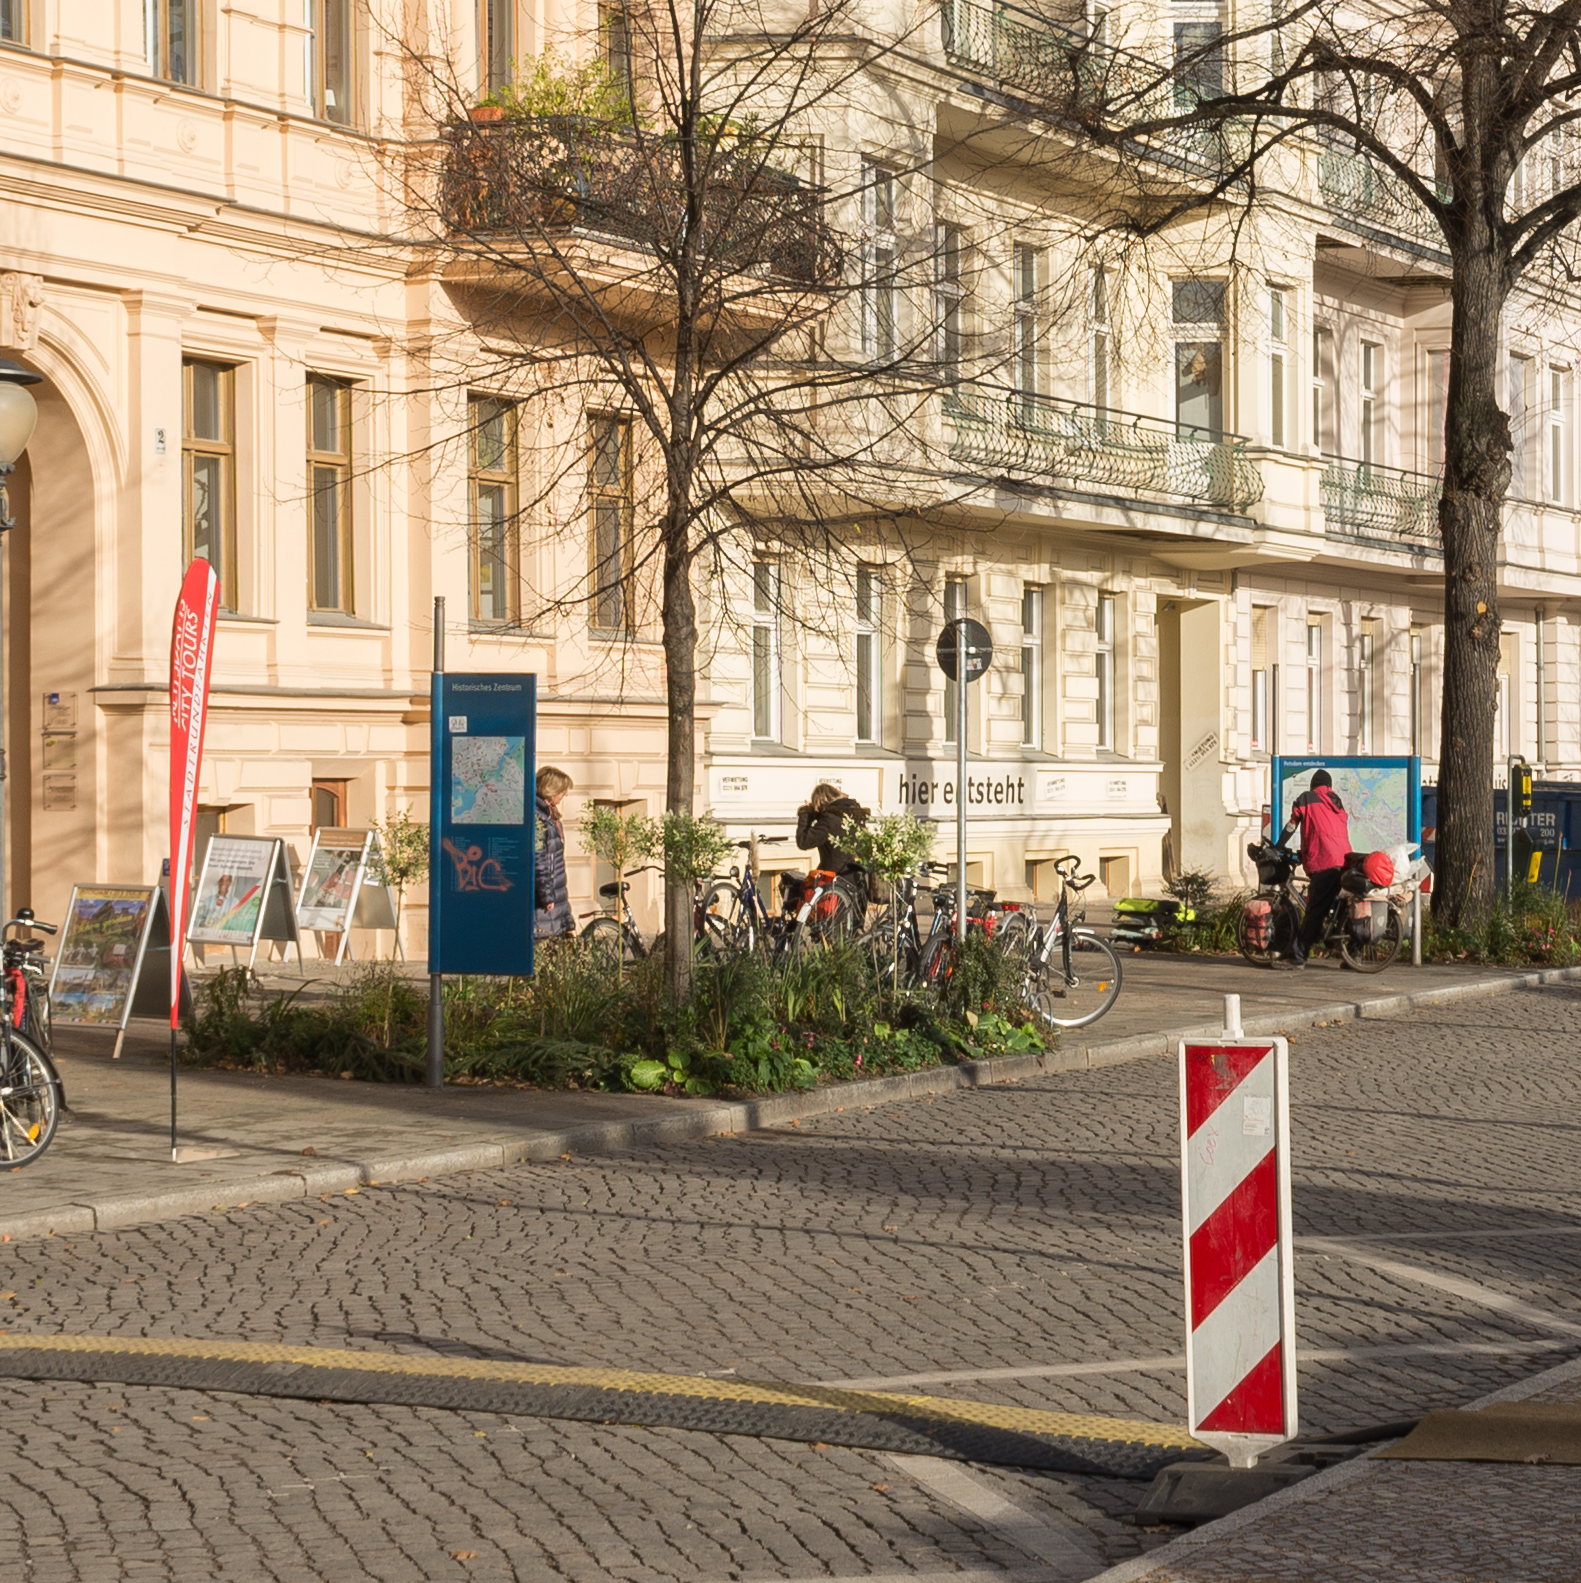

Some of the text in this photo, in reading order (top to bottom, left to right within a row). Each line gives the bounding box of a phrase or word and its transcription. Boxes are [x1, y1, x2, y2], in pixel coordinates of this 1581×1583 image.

[452, 682, 522, 692] Historisches Zentrum
[898, 774, 938, 805] hier
[943, 774, 1025, 805] etsteht
[1496, 811, 1556, 827] RITER
